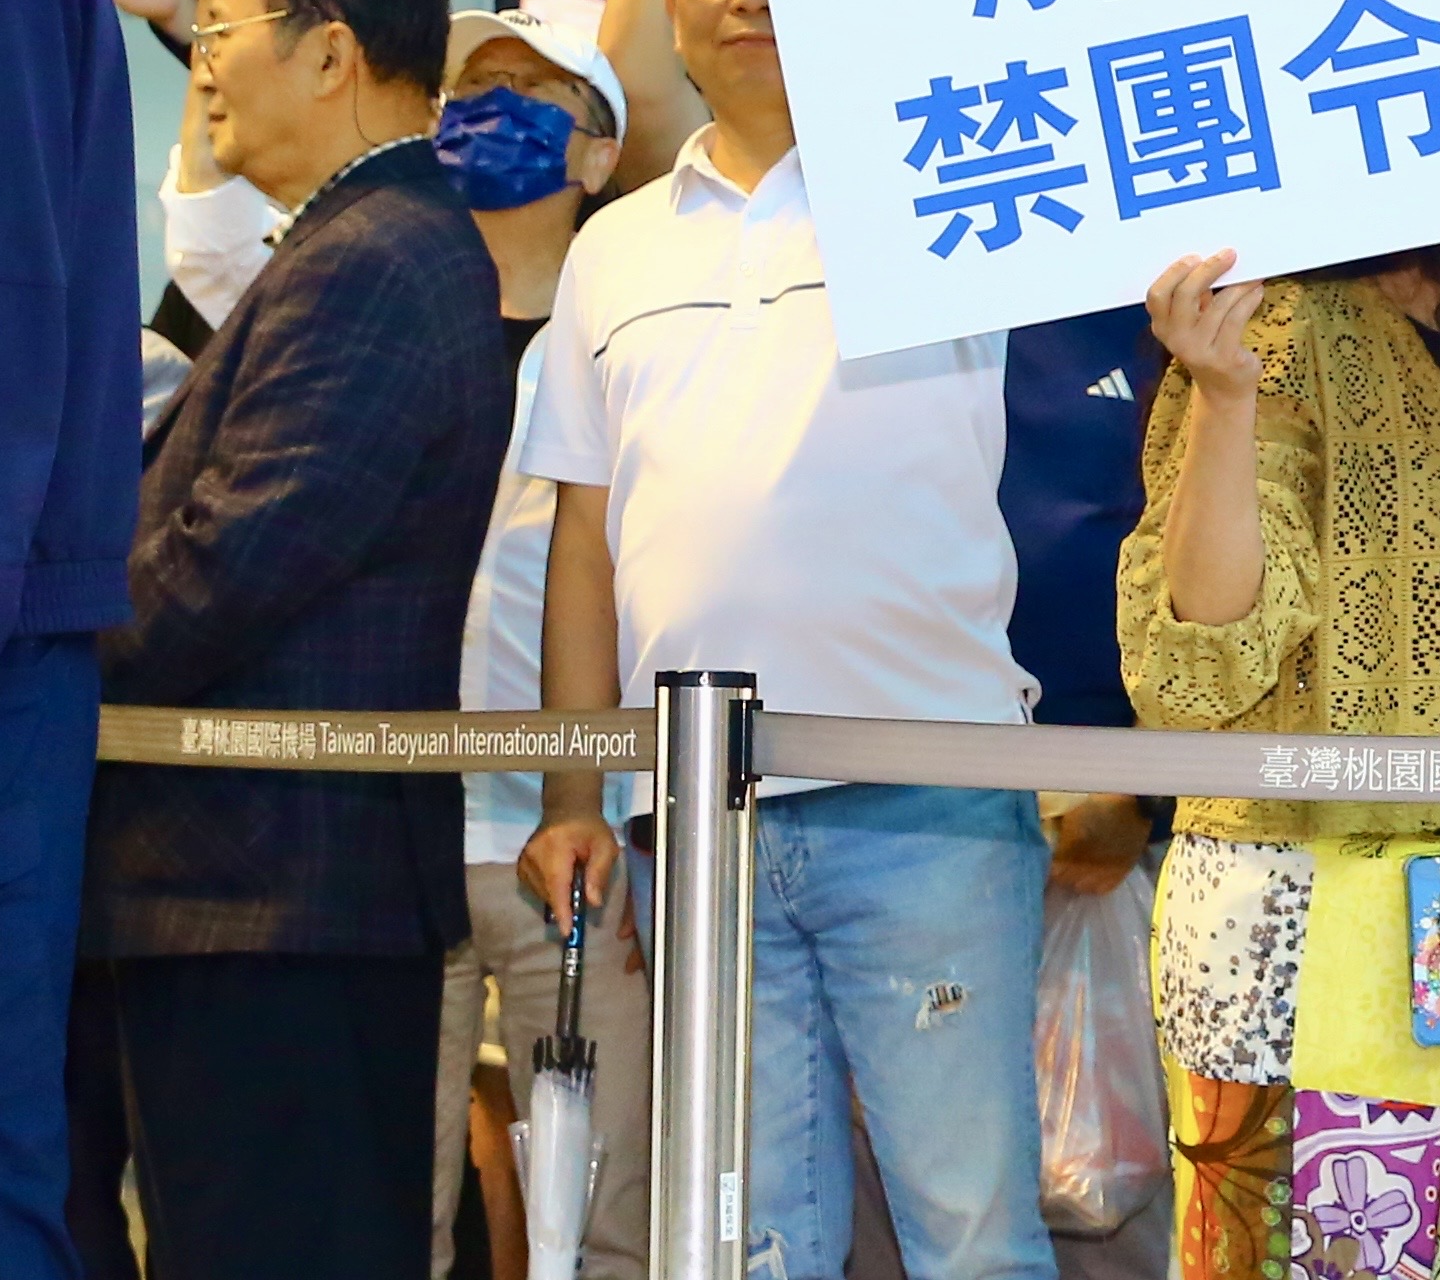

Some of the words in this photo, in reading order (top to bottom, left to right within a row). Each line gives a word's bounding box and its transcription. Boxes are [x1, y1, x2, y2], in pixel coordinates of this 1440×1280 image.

[319, 722, 375, 755] Taiwan
[378, 723, 449, 764] Taoyuan
[454, 723, 564, 756] International
[569, 723, 636, 766] Airport
